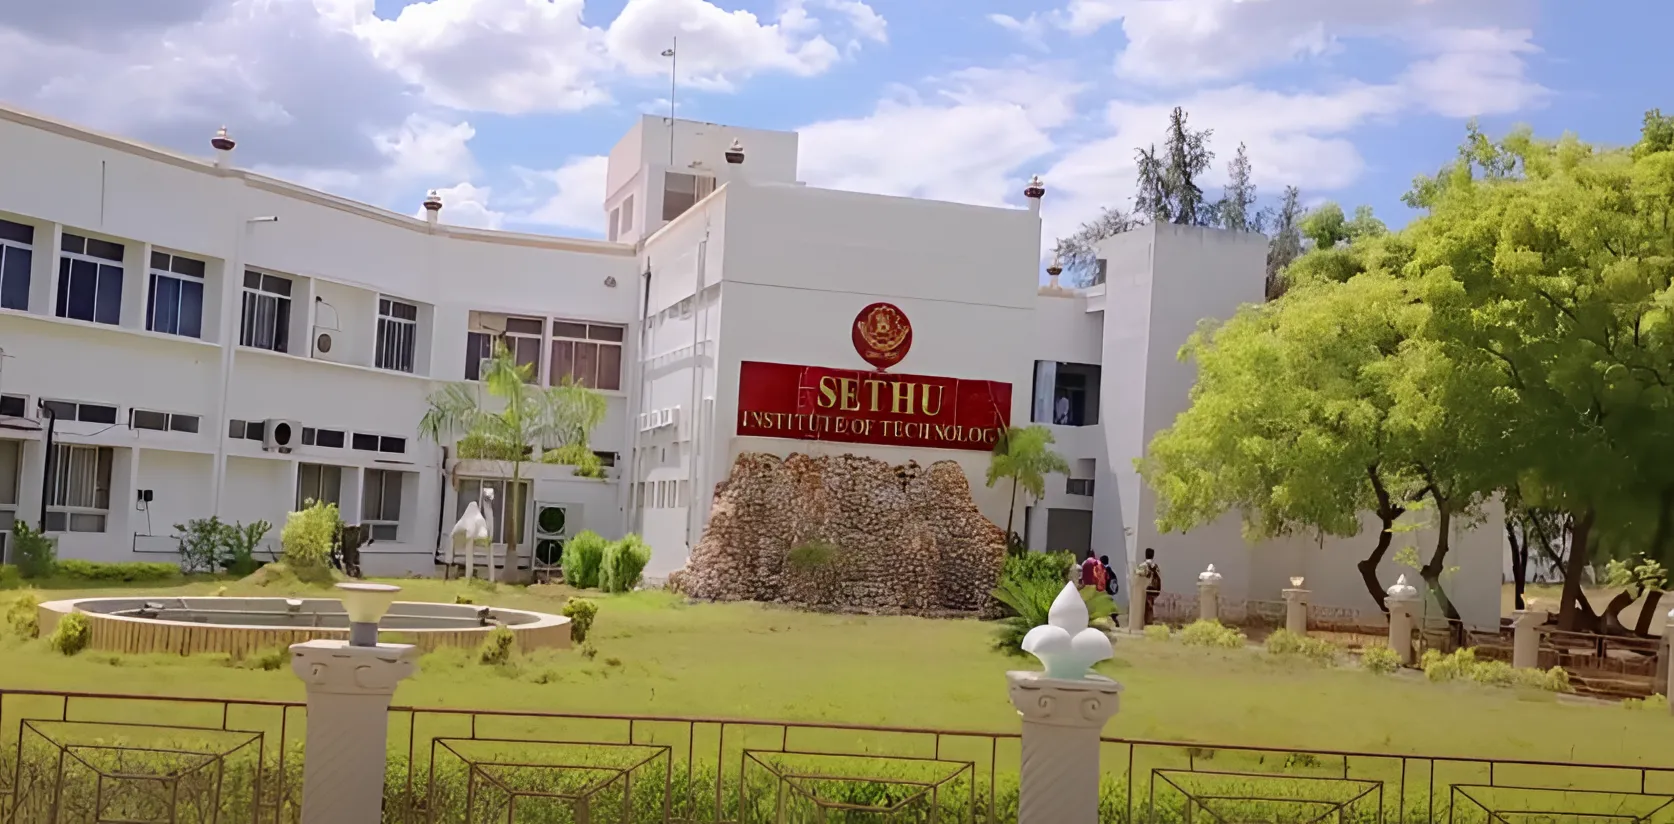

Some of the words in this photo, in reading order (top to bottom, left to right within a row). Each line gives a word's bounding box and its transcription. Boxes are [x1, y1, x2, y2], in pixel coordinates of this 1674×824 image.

[817, 375, 944, 416] SETHU
[743, 410, 847, 433] INSTITUTE
[851, 418, 875, 436] OF
